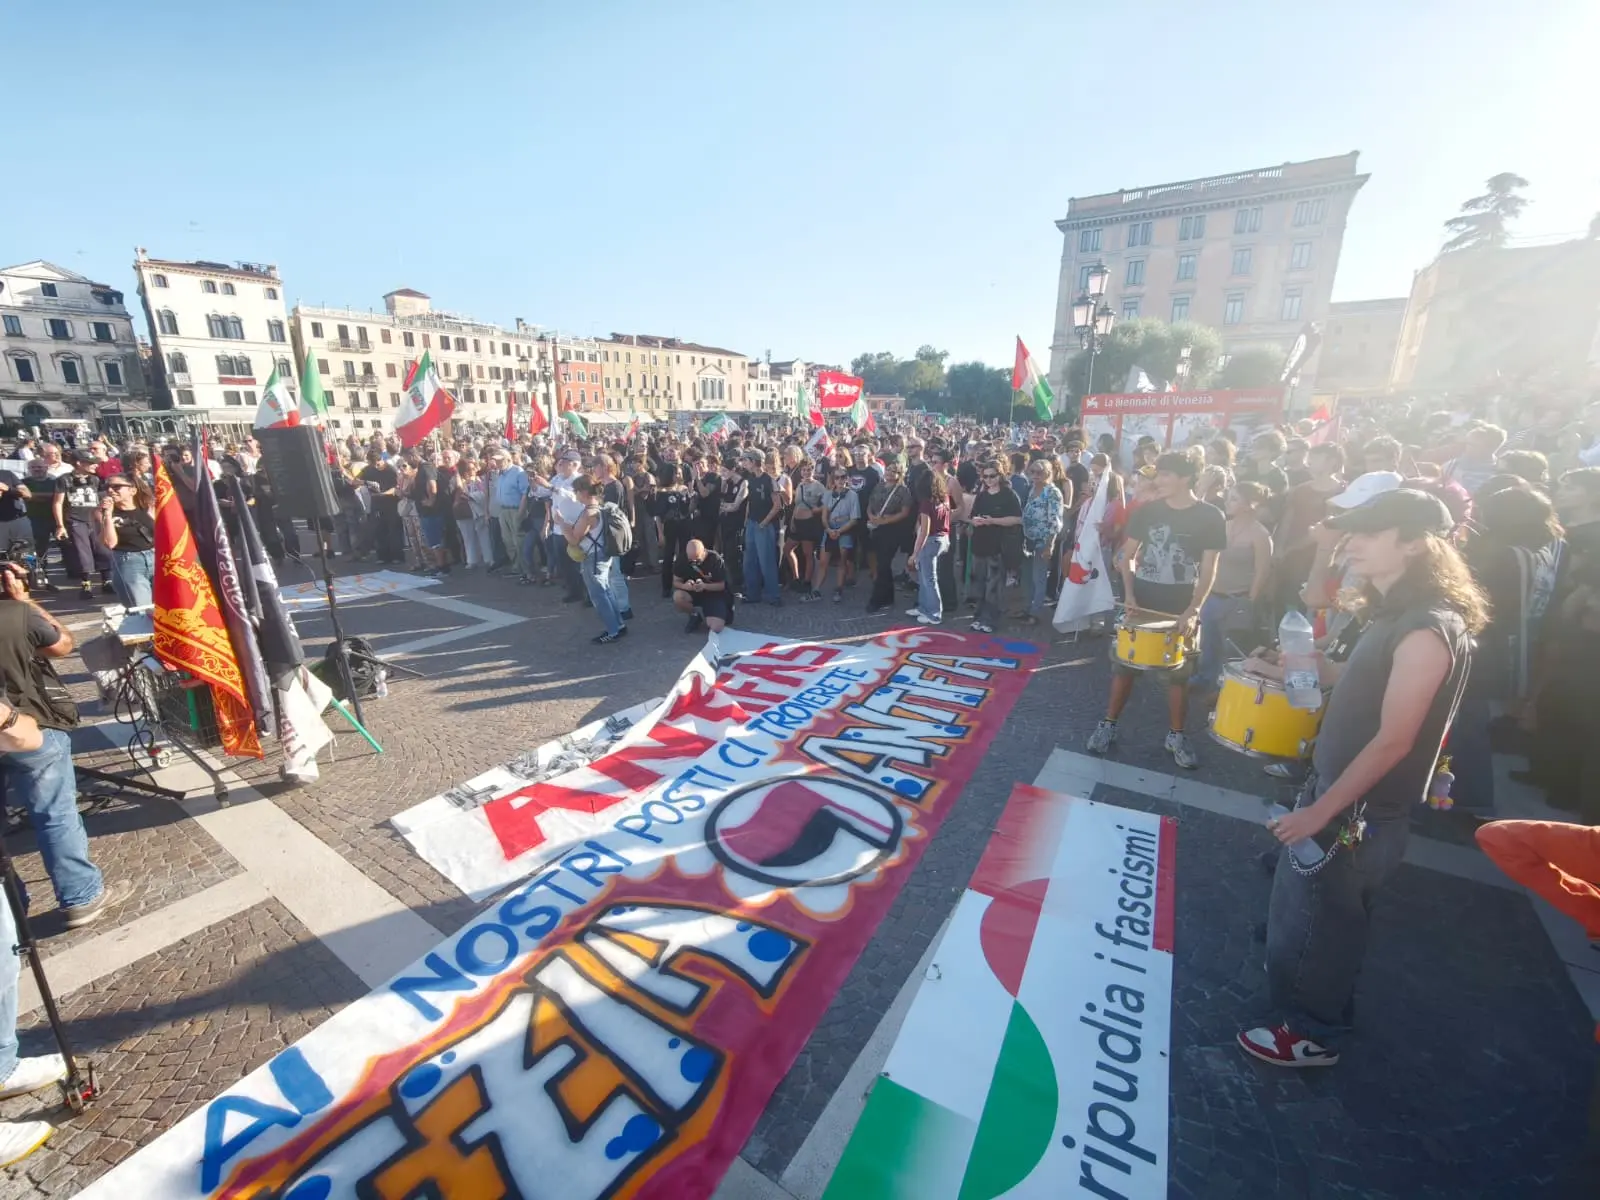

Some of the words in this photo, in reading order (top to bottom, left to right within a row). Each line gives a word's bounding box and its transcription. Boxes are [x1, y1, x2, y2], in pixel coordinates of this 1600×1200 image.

[1104, 397, 1113, 407] La
[1115, 396, 1156, 407] Biennale
[1160, 394, 1170, 405] di
[1173, 394, 1213, 405] Venezia
[799, 651, 1021, 801] ANTIFA
[201, 1046, 334, 1193] AI
[390, 839, 632, 1022] NOSTRI
[614, 764, 736, 844] POSTI
[718, 737, 768, 768] CI
[744, 666, 869, 740] TROVERETE
[1094, 824, 1157, 951] fascismi
[1094, 952, 1147, 974] i
[1062, 983, 1157, 1200] ripudia
